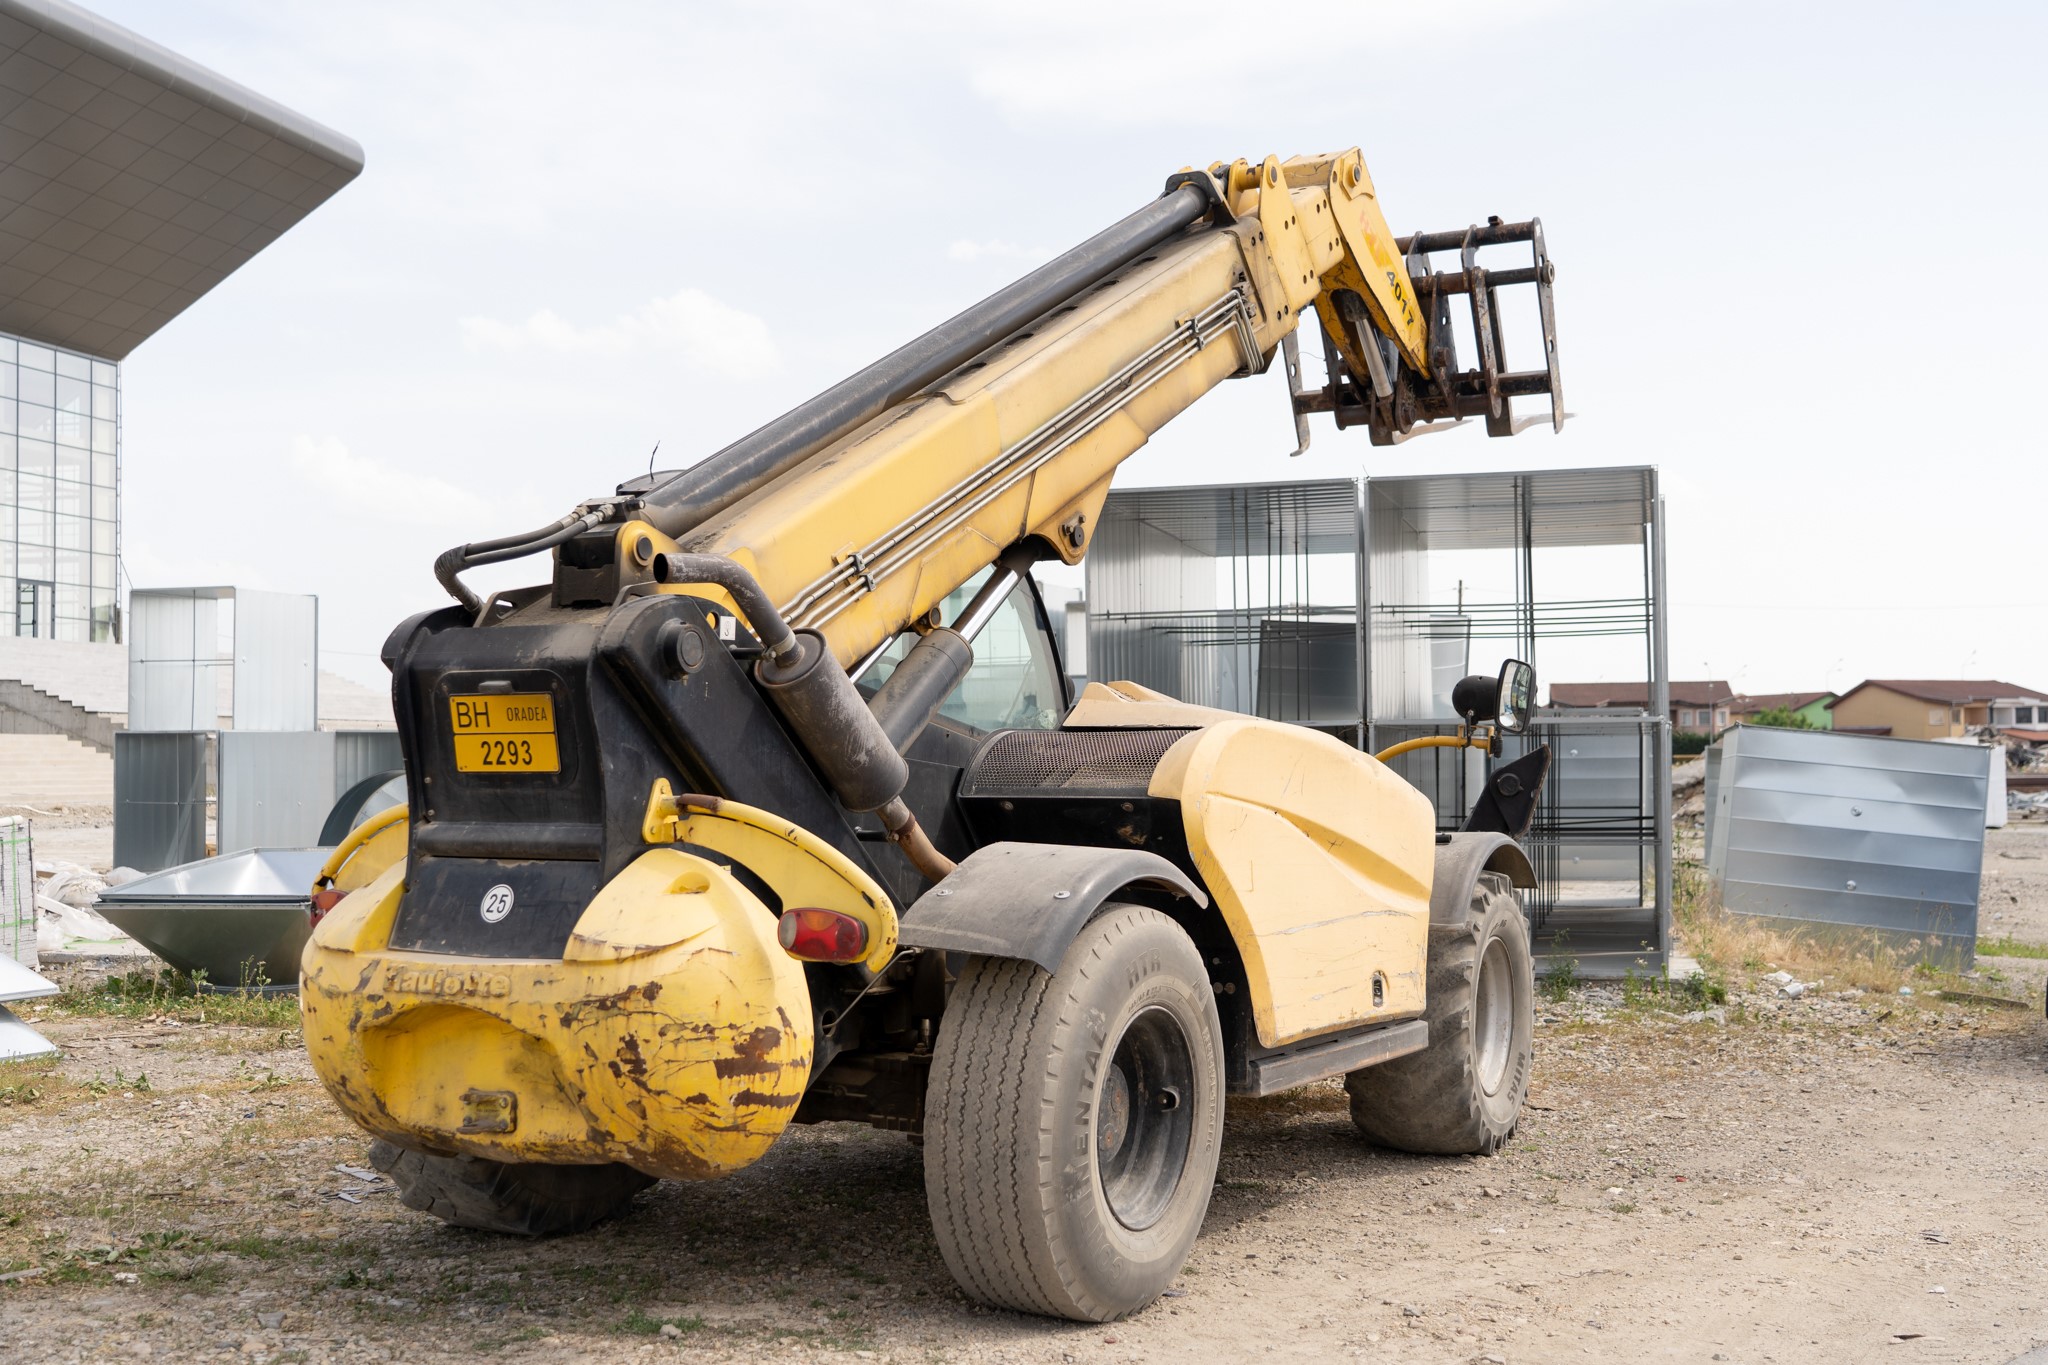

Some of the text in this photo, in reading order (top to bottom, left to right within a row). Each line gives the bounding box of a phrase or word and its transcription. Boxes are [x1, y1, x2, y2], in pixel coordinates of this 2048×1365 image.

[1386, 271, 1414, 326] 4017
[456, 702, 547, 728] BH ORADEA
[481, 740, 532, 765] 2293
[486, 894, 509, 914] 25
[1124, 945, 1161, 990] HTR
[1507, 1051, 1527, 1105] MITAS
